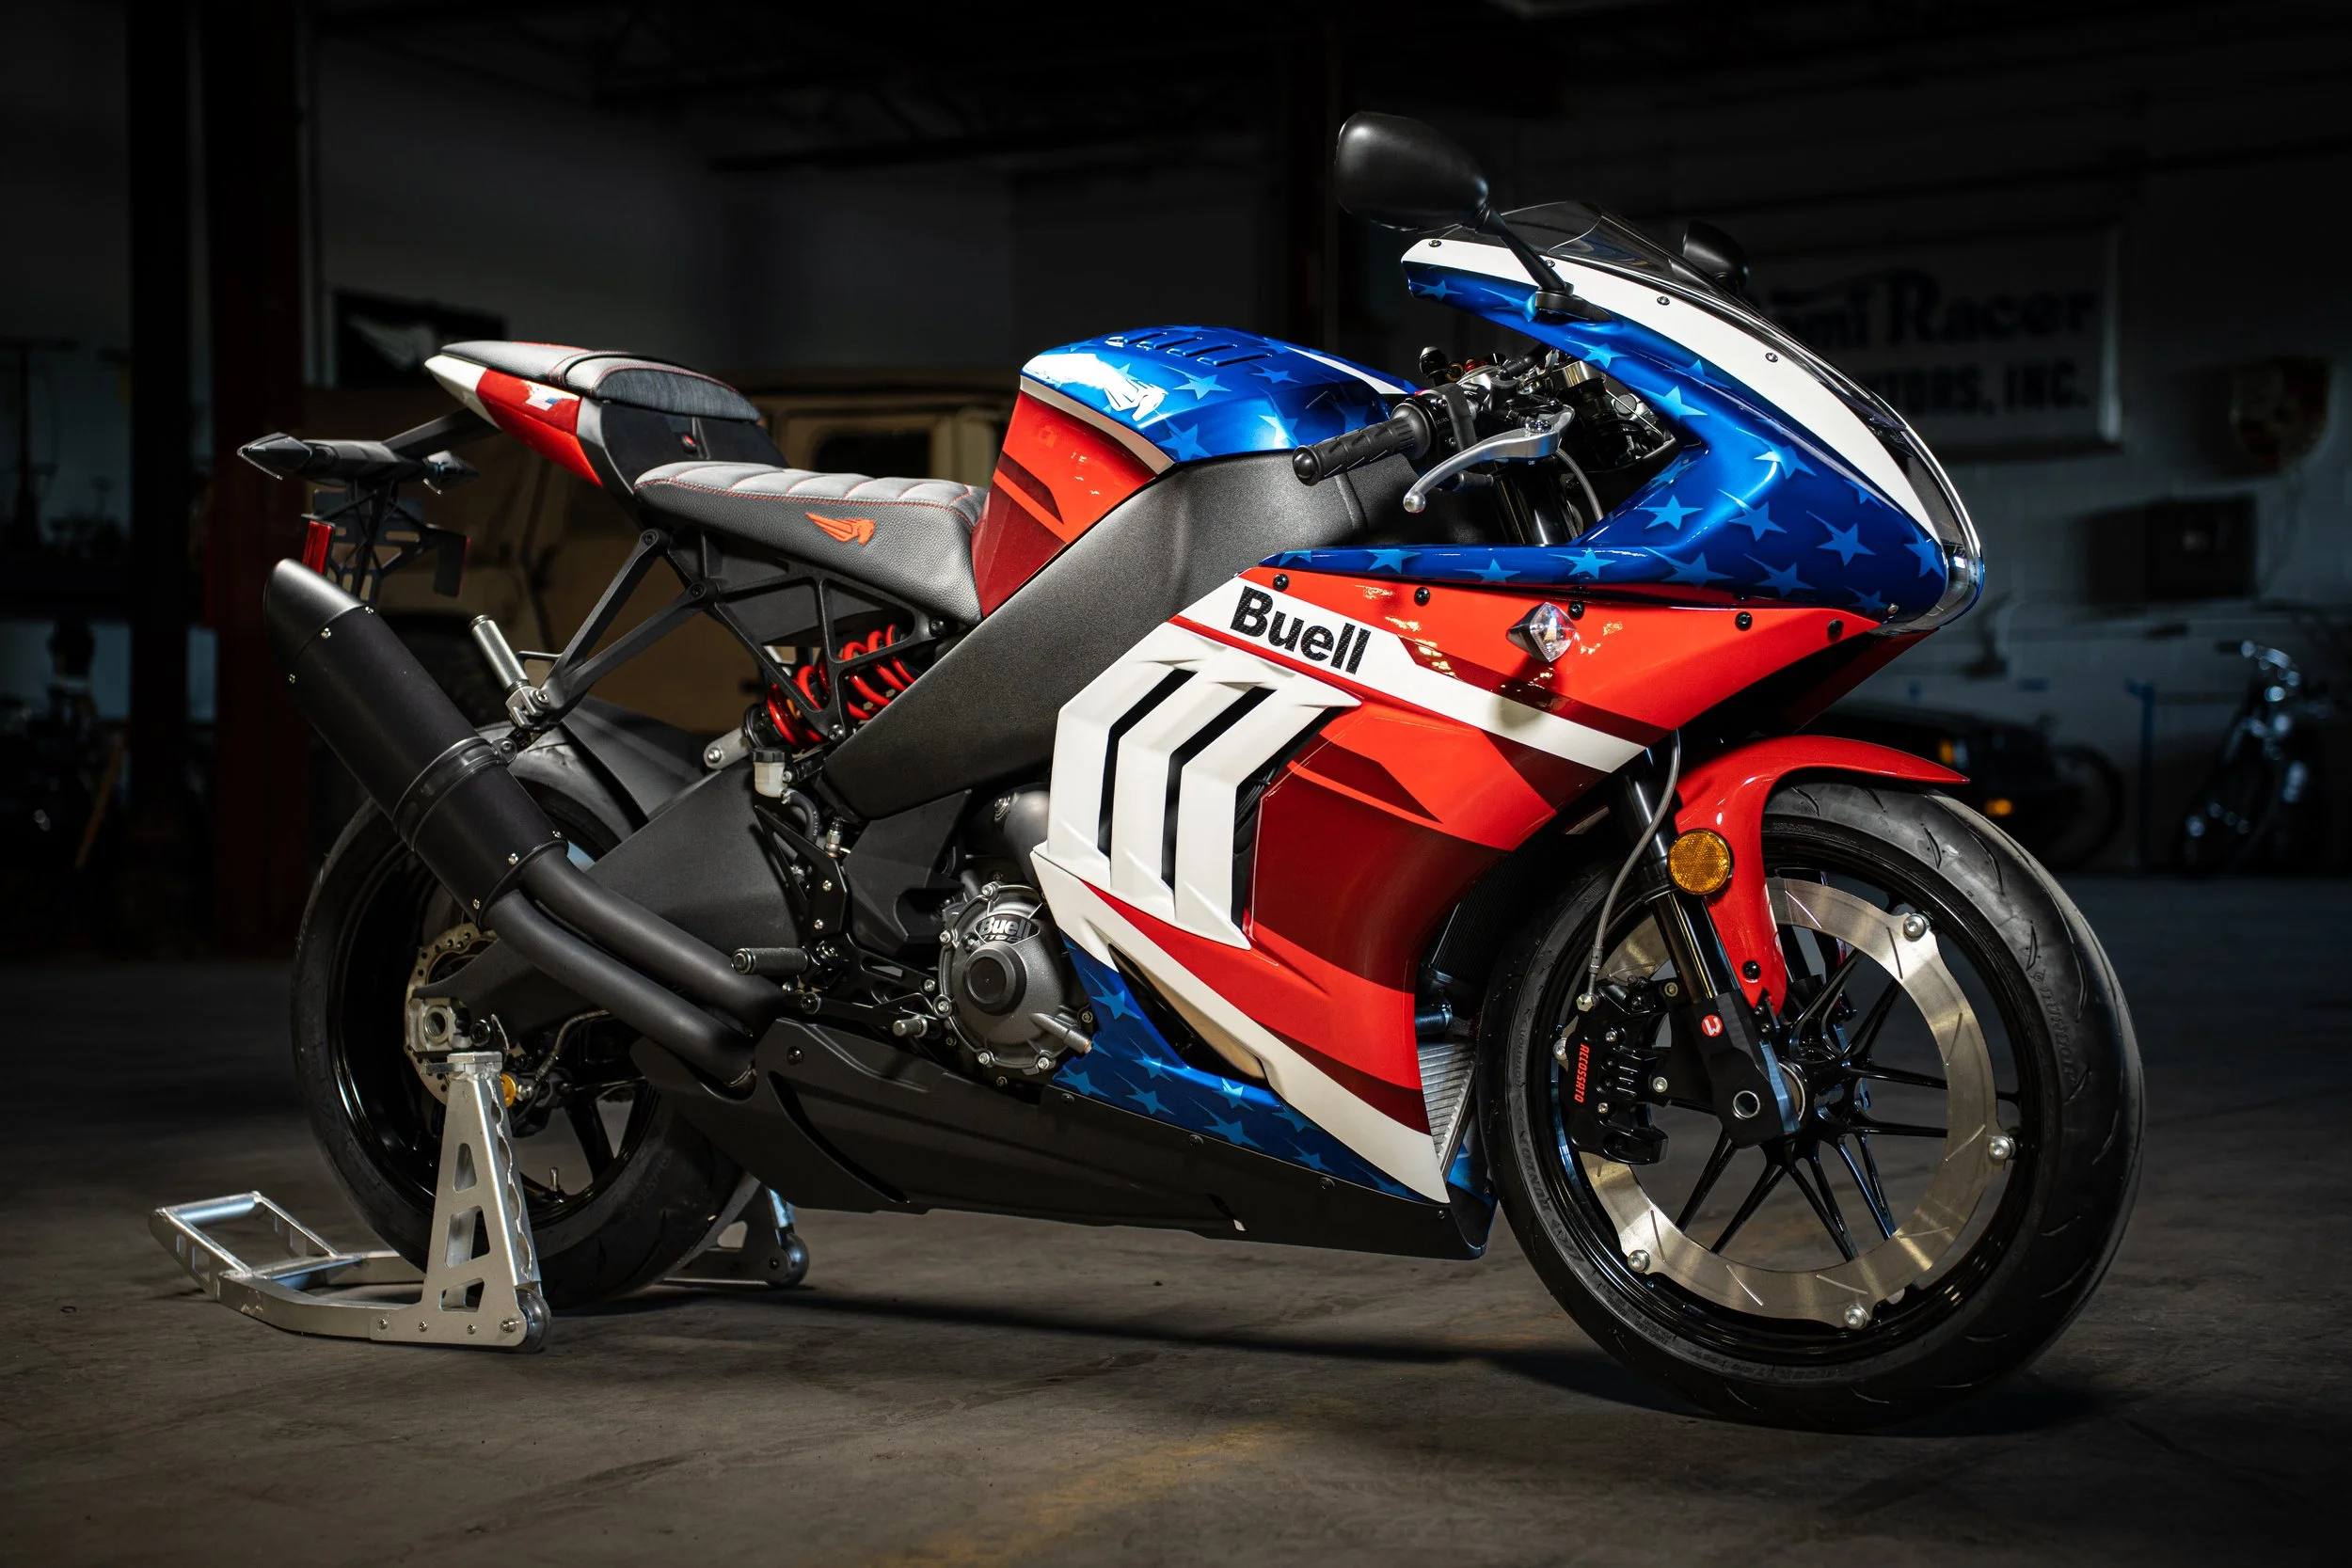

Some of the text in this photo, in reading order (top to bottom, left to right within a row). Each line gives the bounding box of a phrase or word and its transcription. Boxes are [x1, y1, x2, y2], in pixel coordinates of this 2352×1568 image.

[1883, 266, 2097, 343] Racer
[2003, 356, 2090, 412] INC.
[1230, 585, 1371, 674] Buell
[979, 916, 1032, 939] Buell
[1574, 1043, 1590, 1103] ACCOSSATO
